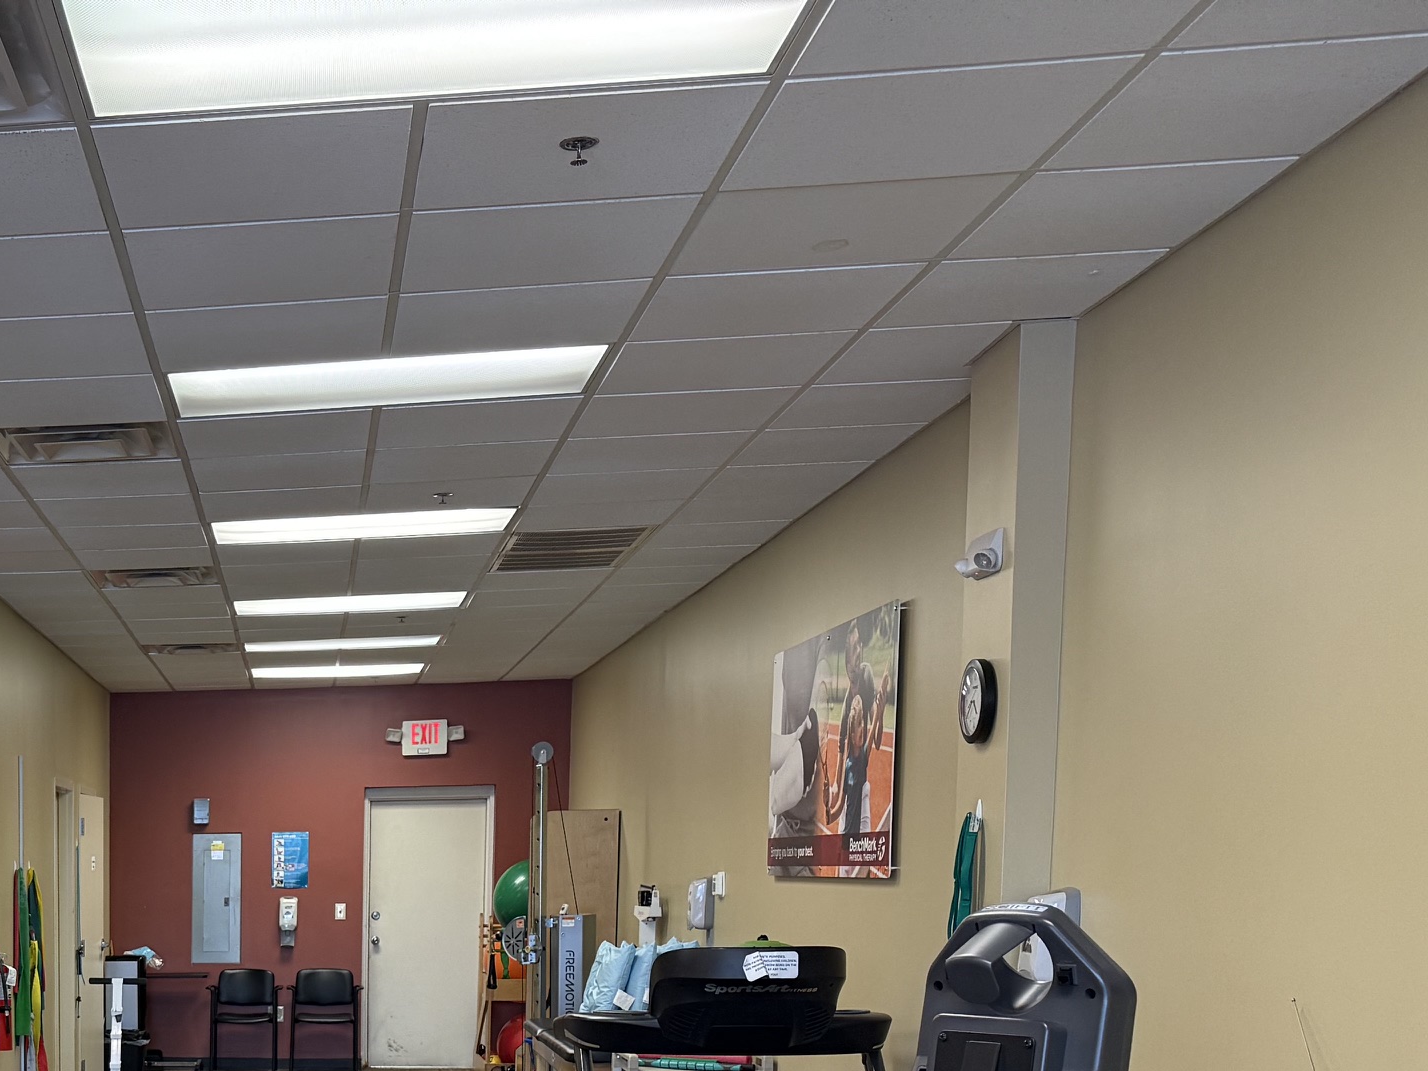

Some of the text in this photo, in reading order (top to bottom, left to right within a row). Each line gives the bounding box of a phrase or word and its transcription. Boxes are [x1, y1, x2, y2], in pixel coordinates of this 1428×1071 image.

[411, 722, 441, 745] EXIT
[849, 837, 877, 852] BenchMark
[704, 983, 789, 995] SportsArt
